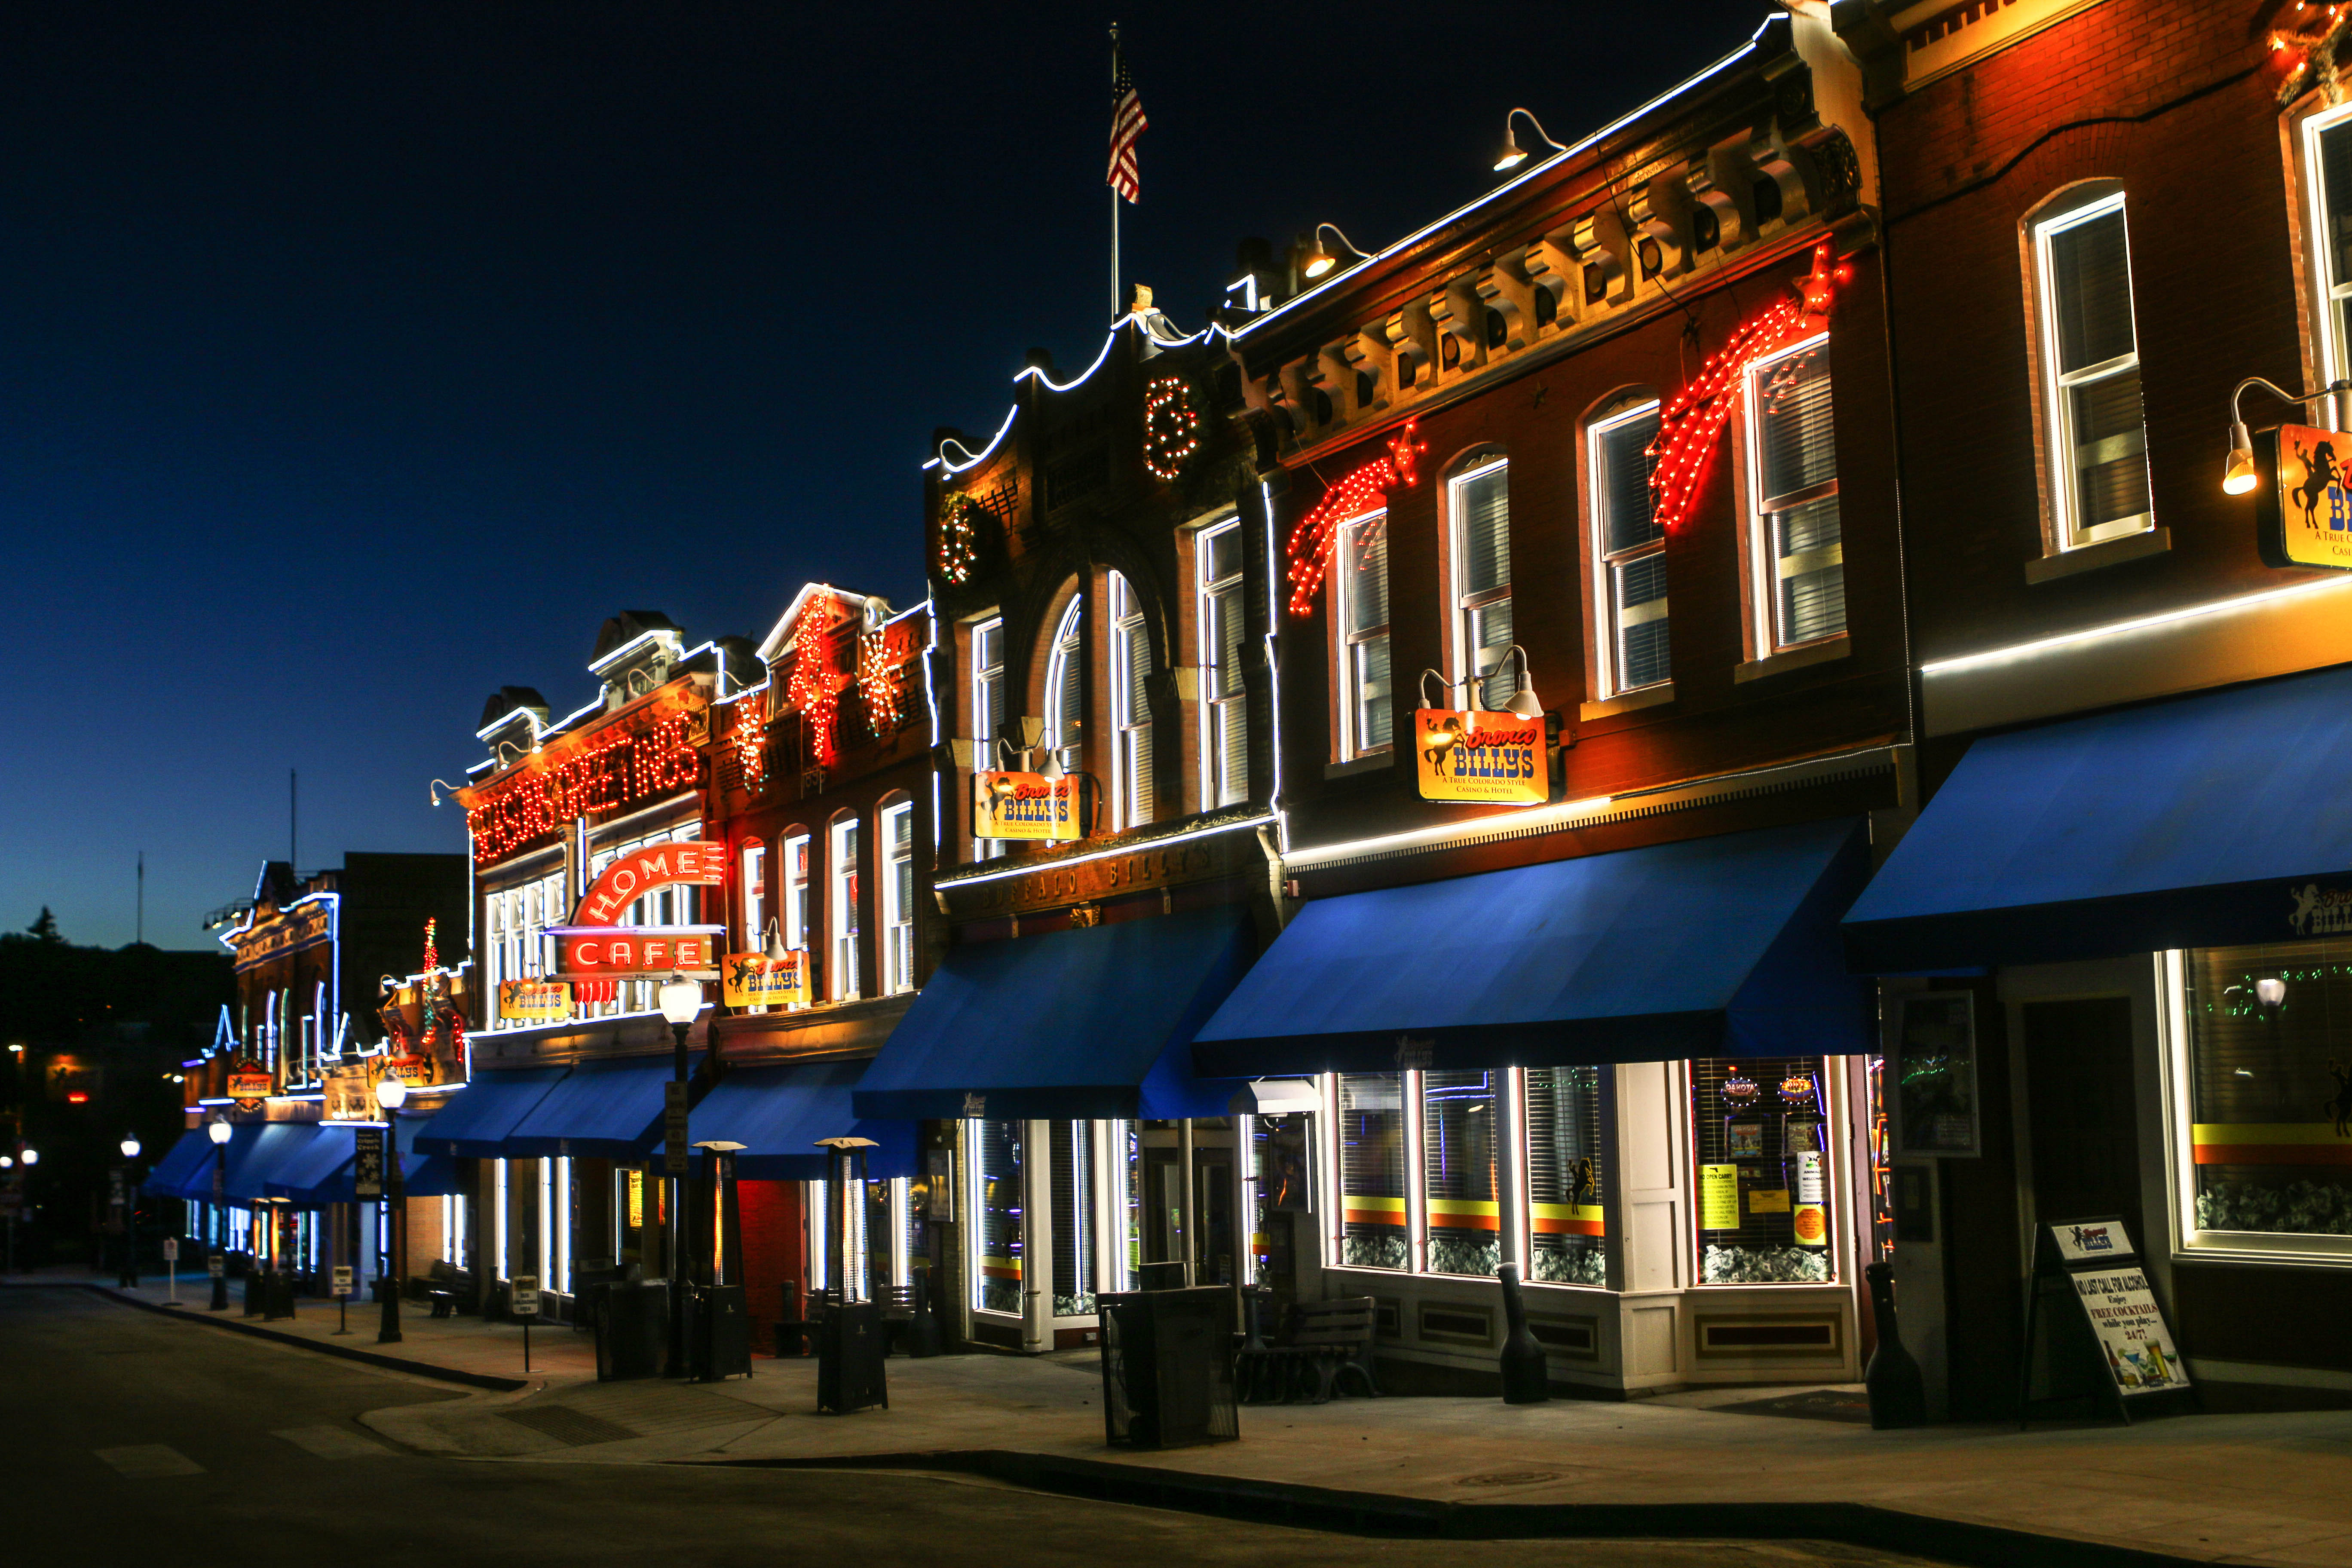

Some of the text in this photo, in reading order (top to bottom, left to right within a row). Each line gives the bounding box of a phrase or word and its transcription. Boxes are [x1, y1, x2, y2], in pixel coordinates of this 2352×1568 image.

[2315, 531, 2321, 540] A
[2323, 531, 2346, 542] TRUE
[1464, 726, 1537, 750] Bronco
[1453, 746, 1534, 778] BILLY'S
[1014, 784, 1072, 800] Bronco
[1004, 798, 1068, 822] BILLY'S
[588, 850, 699, 923] HOME
[575, 941, 700, 966] CAFE
[2084, 1278, 2100, 1295] LAST
[2098, 1278, 2114, 1294] CALL
[2110, 1277, 2125, 1293] FOR
[2122, 1274, 2150, 1292] ALCOHOL
[2107, 1295, 2126, 1305] Enjoy
[2091, 1303, 2159, 1319] FREE COCKTAILS
[2102, 1318, 2122, 1328] while
[2122, 1320, 2135, 1329] you
